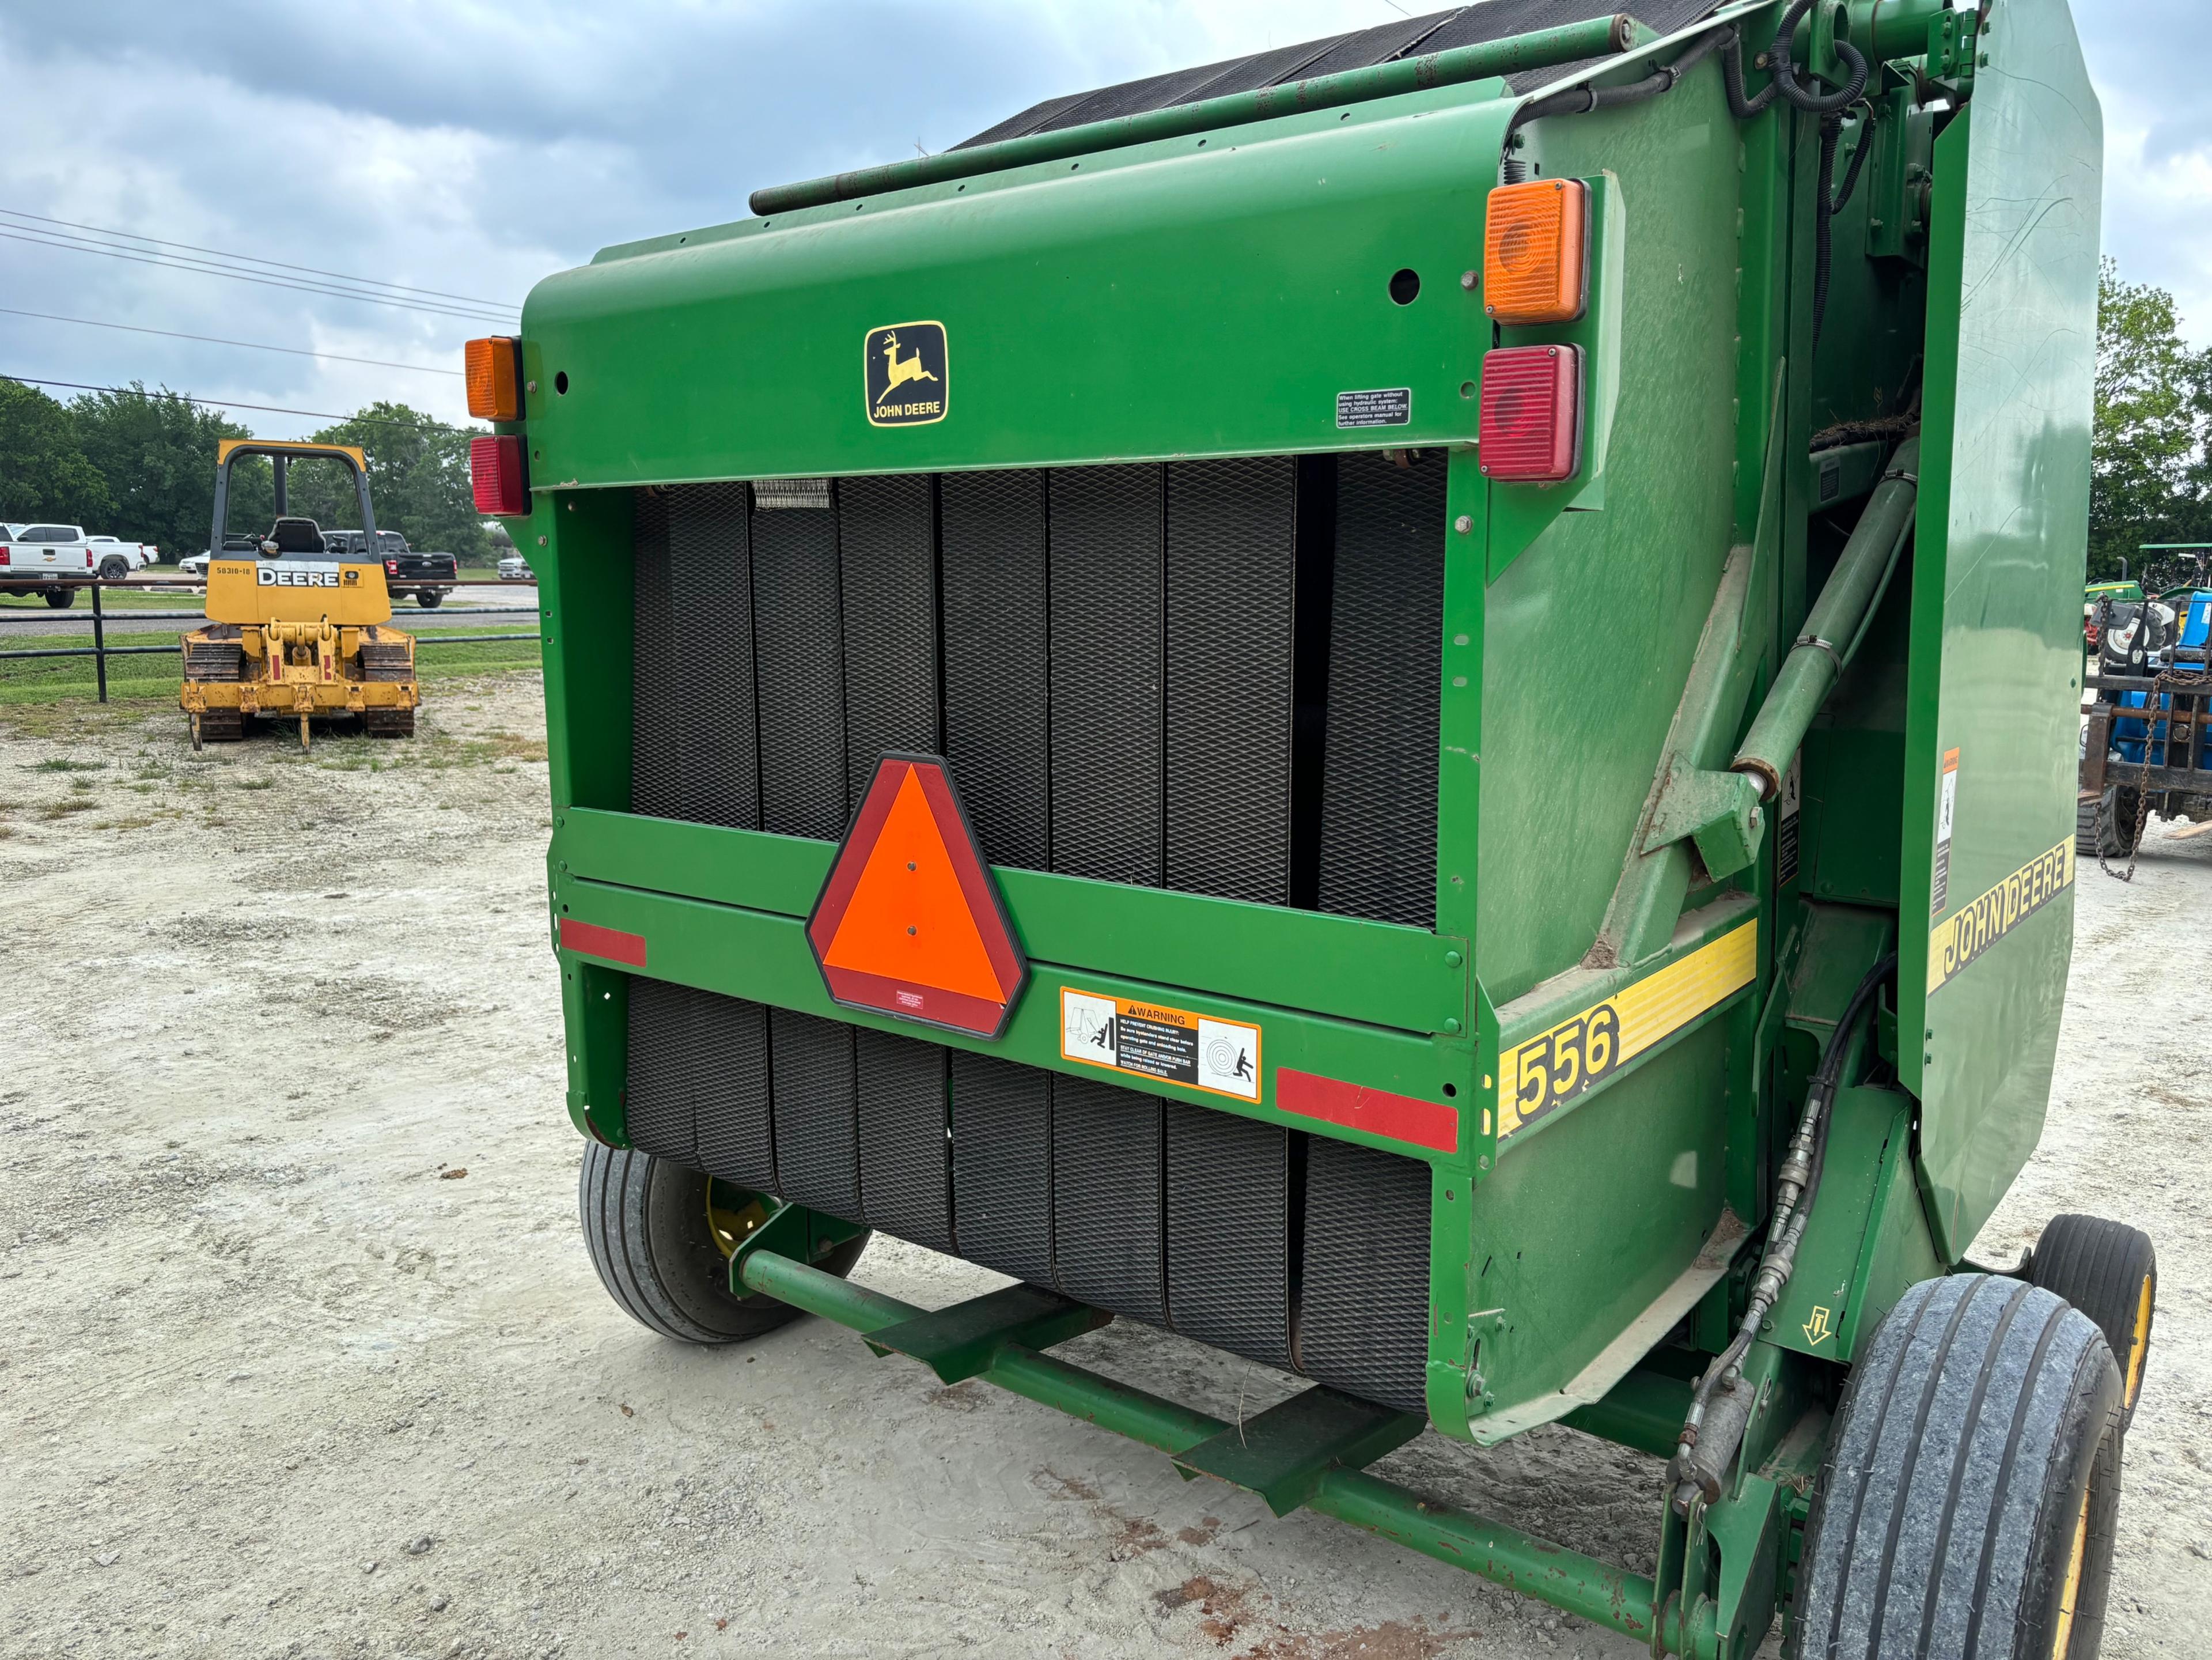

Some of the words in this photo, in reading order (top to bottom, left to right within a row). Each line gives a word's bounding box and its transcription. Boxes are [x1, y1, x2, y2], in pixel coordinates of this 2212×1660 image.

[874, 404, 902, 418] JOHN
[904, 401, 940, 415] DEERE
[257, 568, 339, 587] DEERE
[1944, 887, 2008, 975] JOHN
[2007, 844, 2065, 926] DEERE
[1137, 1007, 1184, 1025] WARNING
[1136, 1030, 1157, 1038] bystanders
[1157, 1043, 1176, 1051] unloading
[1517, 1006, 1618, 1120] 556
